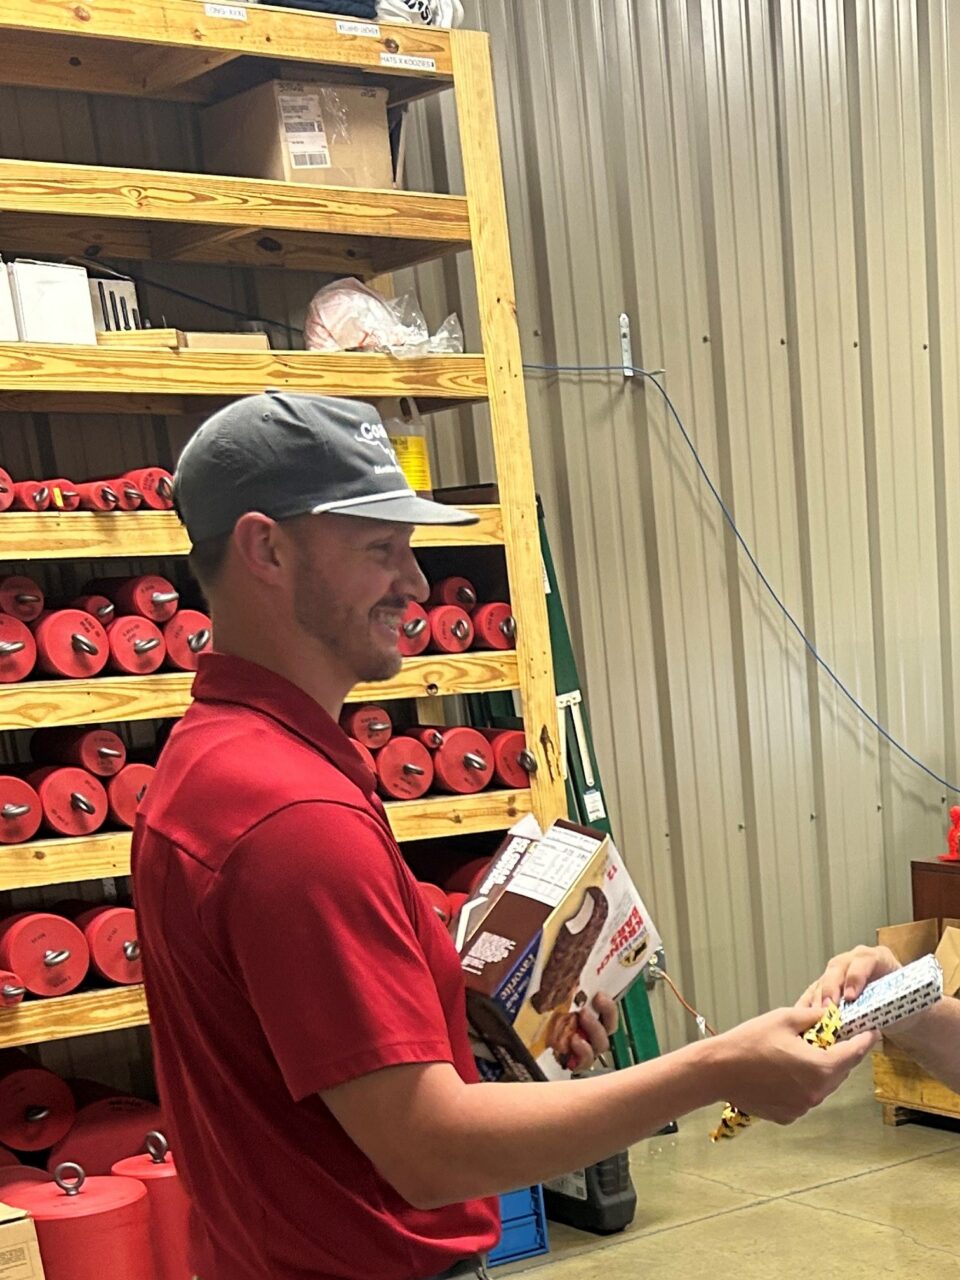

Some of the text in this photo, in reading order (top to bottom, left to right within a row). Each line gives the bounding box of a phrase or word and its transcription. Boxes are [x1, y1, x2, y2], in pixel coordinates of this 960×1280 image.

[606, 865, 618, 881] 12
[597, 916, 644, 975] KRUNCH
[611, 906, 639, 944] BARS
[499, 953, 536, 1001] Favorite
